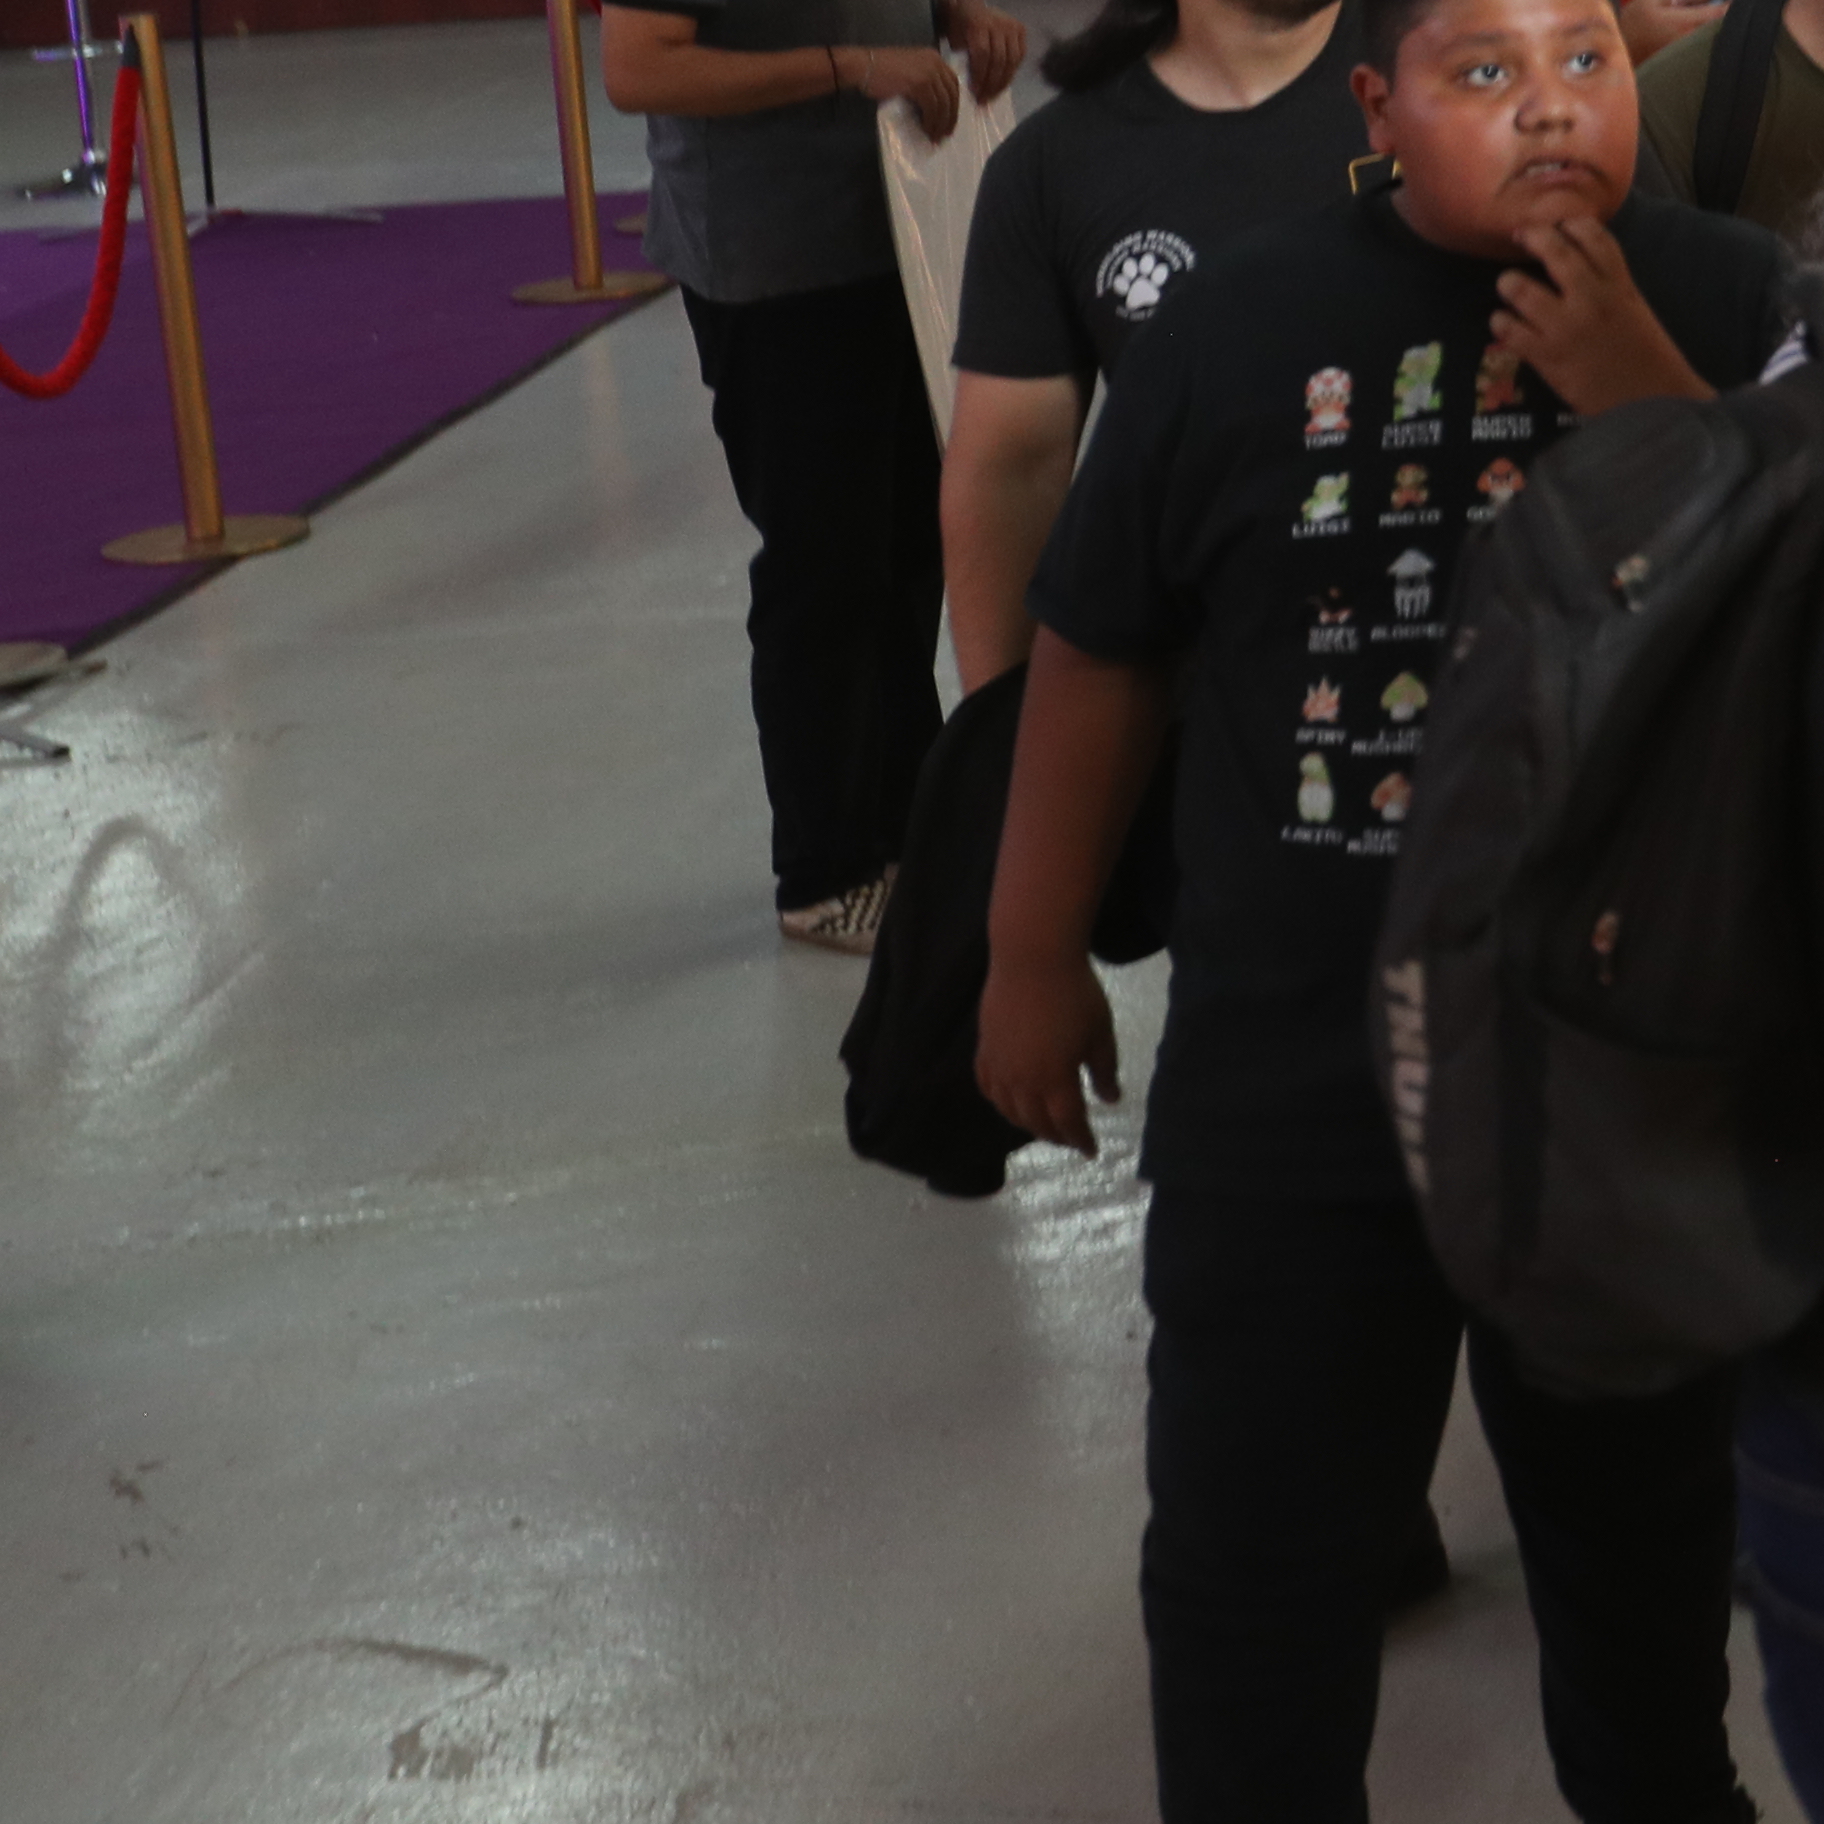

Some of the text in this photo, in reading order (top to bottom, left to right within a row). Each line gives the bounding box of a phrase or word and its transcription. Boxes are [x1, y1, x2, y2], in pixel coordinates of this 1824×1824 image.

[1304, 431, 1347, 450] TOAD
[1291, 516, 1352, 539] LUIGI
[1379, 509, 1441, 527] MARIO
